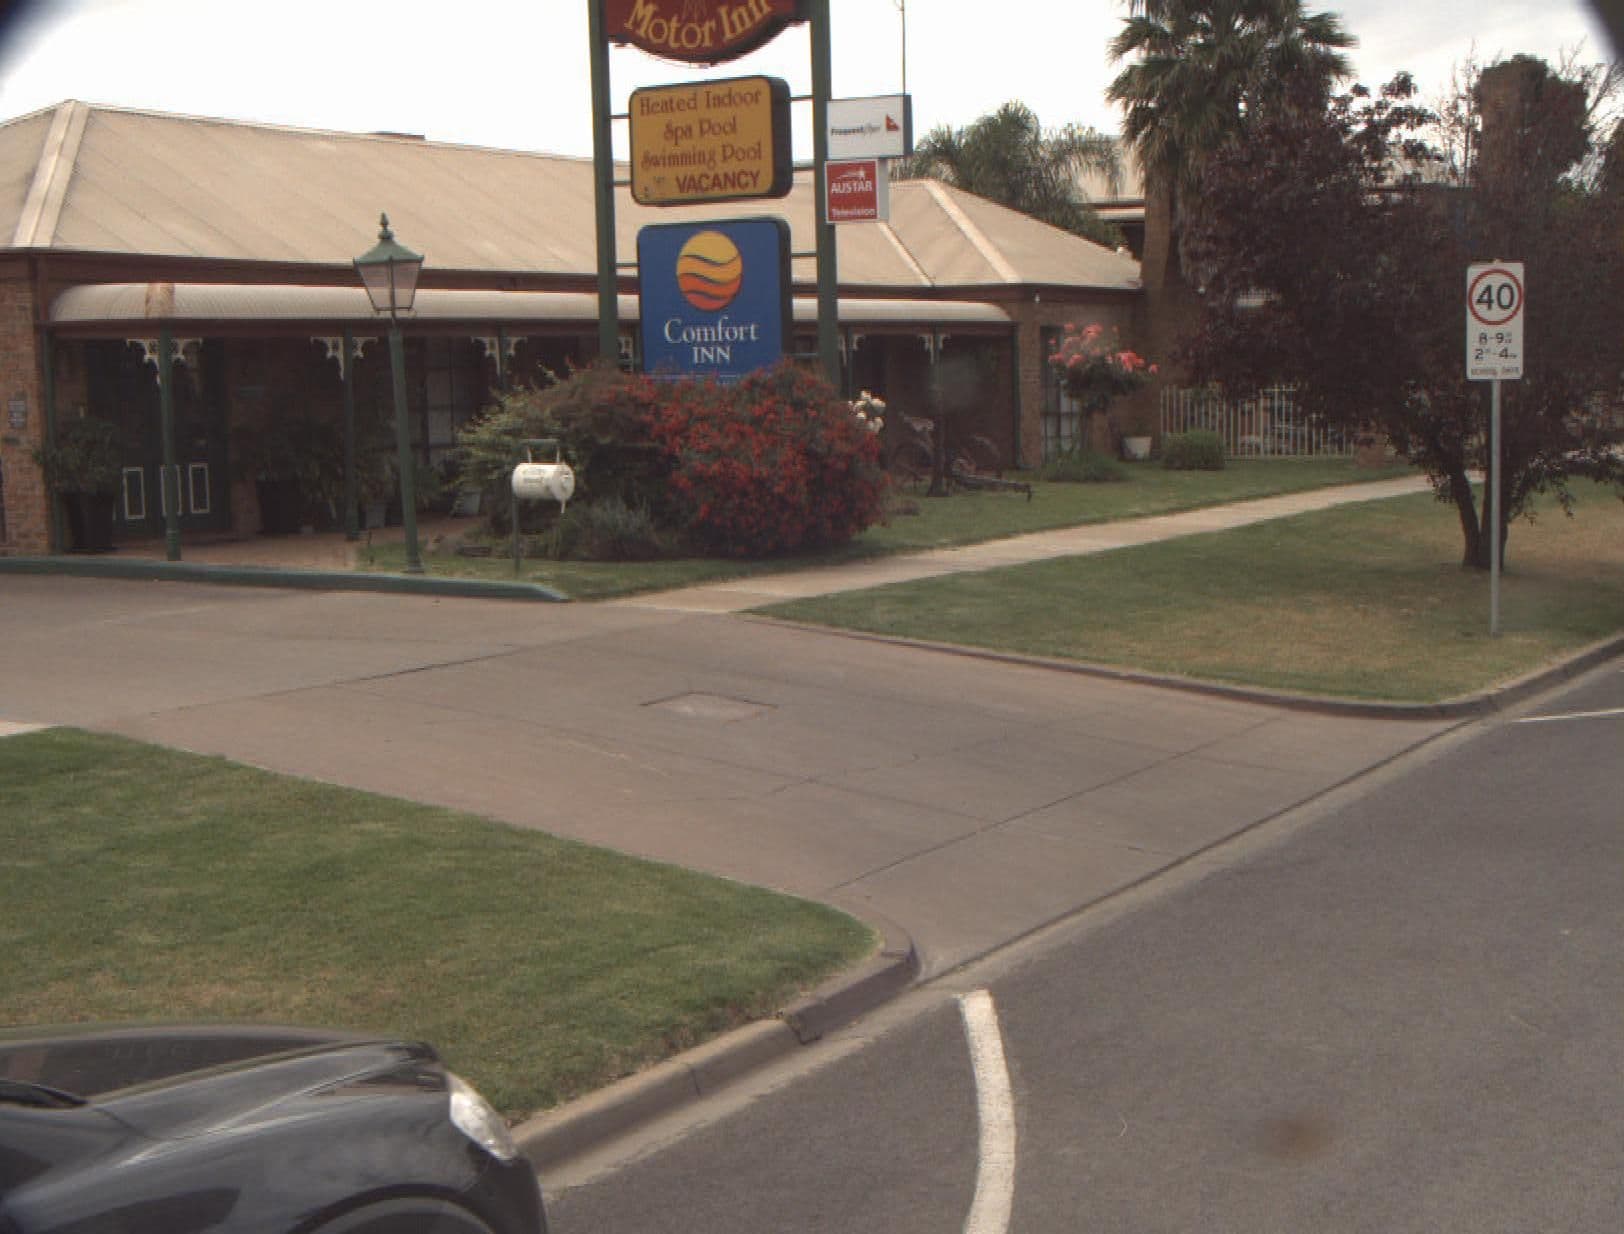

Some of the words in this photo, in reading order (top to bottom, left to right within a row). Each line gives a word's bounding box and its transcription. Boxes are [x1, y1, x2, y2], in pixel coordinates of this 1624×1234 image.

[624, 0, 716, 48] Motor
[718, 0, 773, 42] Inn
[640, 92, 698, 116] Heated
[704, 86, 762, 109] Indoor
[663, 121, 693, 146] Spa
[699, 115, 737, 137] Pool
[640, 146, 717, 171] Swimming
[720, 141, 763, 163] Pool
[675, 170, 760, 194] VACANCY
[1475, 282, 1515, 311] 40
[664, 315, 760, 344] Comfort
[692, 345, 732, 364] INN
